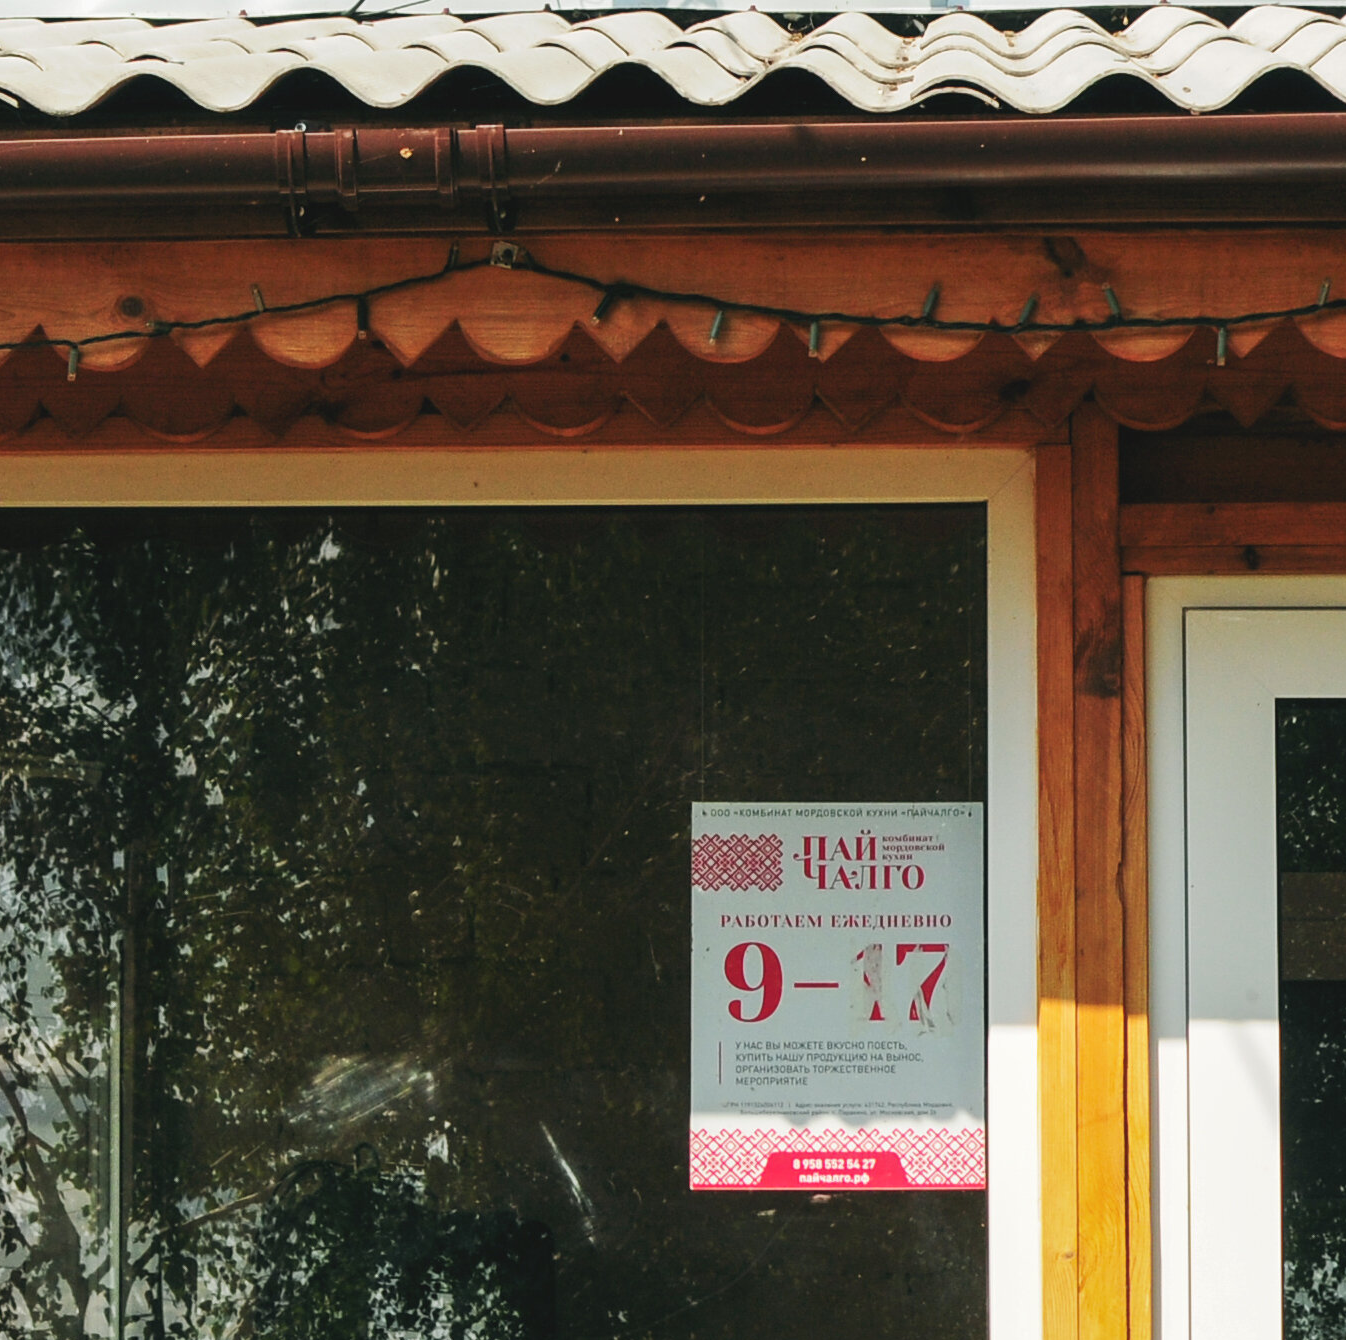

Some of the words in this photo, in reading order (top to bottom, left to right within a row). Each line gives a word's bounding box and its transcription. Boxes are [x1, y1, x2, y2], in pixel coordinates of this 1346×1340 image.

[710, 809, 731, 817] ООО
[795, 807, 863, 818] МОРДОВСКОЙ
[866, 808, 898, 817] КУХНИ
[901, 807, 965, 817] «ПАЙЧАЛГО»
[882, 834, 934, 842] комбинат
[801, 829, 877, 861] ПАЙ
[882, 842, 946, 853] мордовской
[882, 853, 913, 862] кухни
[795, 858, 925, 890] ЧАЛГО
[720, 914, 823, 928] РАБОТАЕМ
[830, 914, 952, 931] ЕЖЕДНЕВНО
[735, 1041, 742, 1050] У
[743, 1041, 763, 1050] НАС
[765, 1041, 781, 1050] ВЫ
[783, 1041, 824, 1050] МОЖЕТЕ
[826, 1041, 865, 1050] ВКУСНО
[867, 1041, 908, 1051] ПОЕСТЬ,
[735, 1053, 774, 1062] КУПИТЬ
[775, 1053, 804, 1062] НАШУ
[806, 1053, 868, 1063] ПРОДУКЦИЮ
[870, 1053, 884, 1062] НА
[886, 1053, 924, 1063] ВЫНОС,
[735, 1065, 811, 1074] ОРГАНИЗОВАТЬ
[812, 1065, 896, 1074] ТОРЖЕСТВЕННОЕ
[735, 1077, 808, 1086] МЕРОПРИЯТИЕ
[792, 1158, 801, 1170] 8
[824, 1158, 845, 1170] 552
[846, 1158, 860, 1170] 54
[862, 1158, 876, 1170] 27
[798, 1172, 870, 1185] пайчалго.рф
